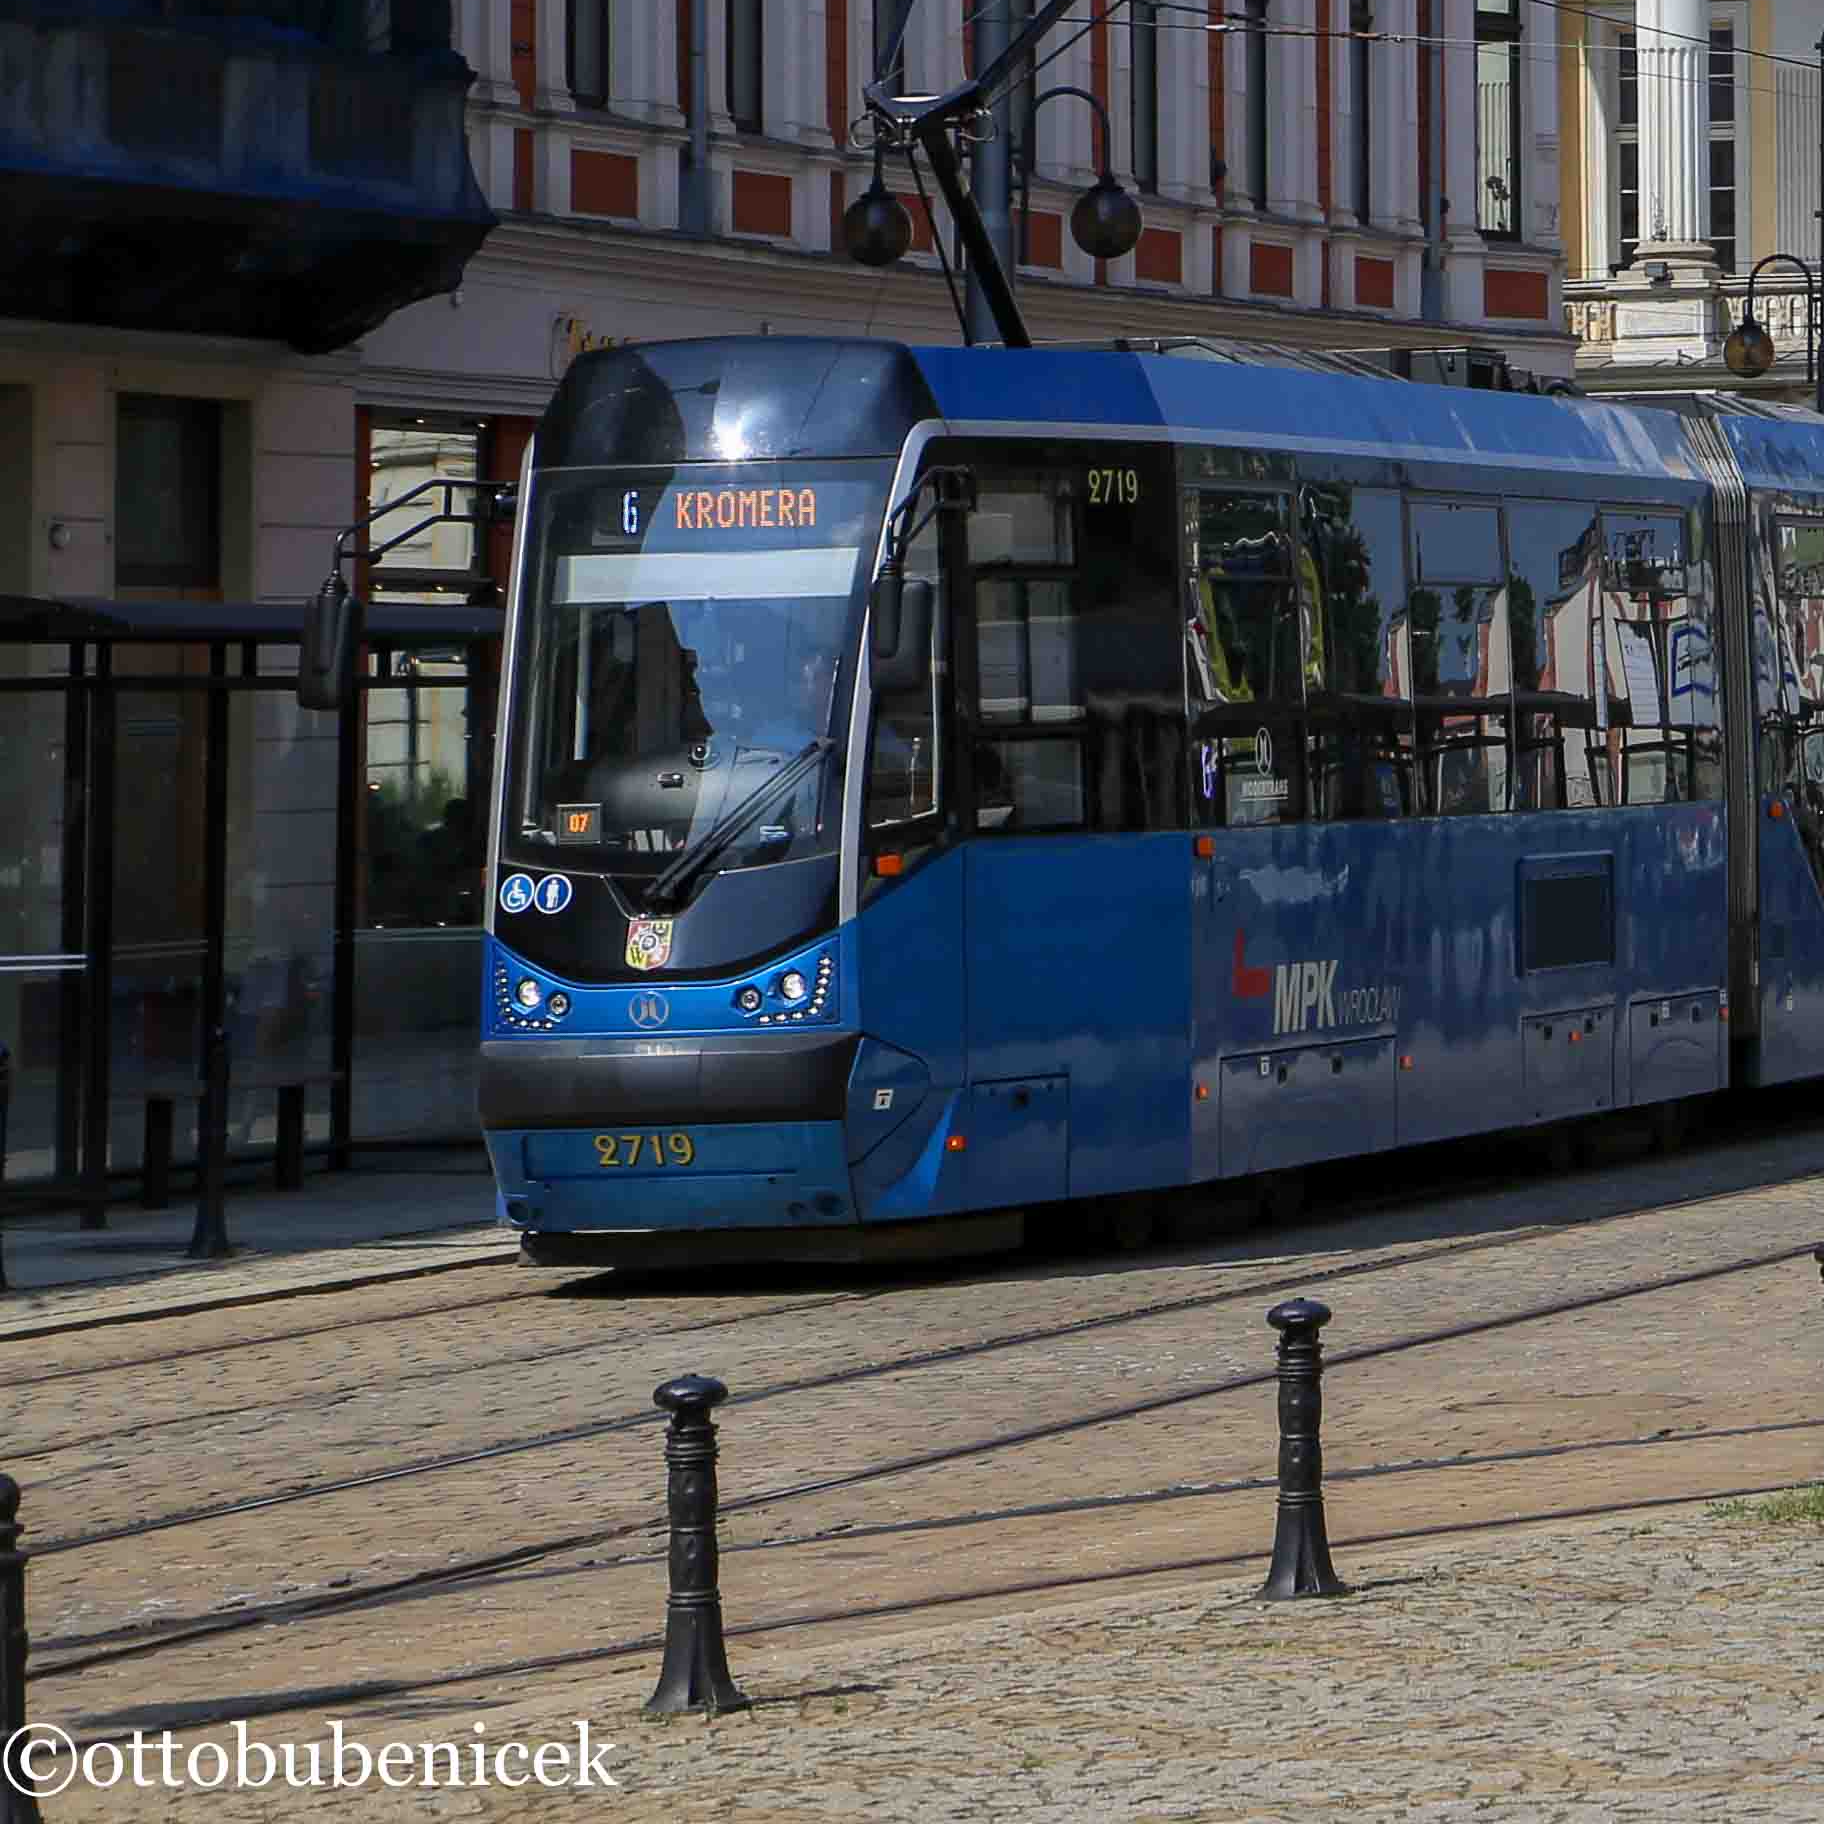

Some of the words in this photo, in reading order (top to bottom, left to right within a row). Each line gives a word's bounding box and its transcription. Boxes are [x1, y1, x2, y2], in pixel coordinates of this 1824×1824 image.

[1087, 469, 1138, 505] 2719
[622, 490, 640, 534] 6
[676, 488, 816, 529] KROMERA
[567, 813, 589, 833] 07
[1273, 959, 1339, 1035] MPK
[593, 1133, 695, 1168] 2719
